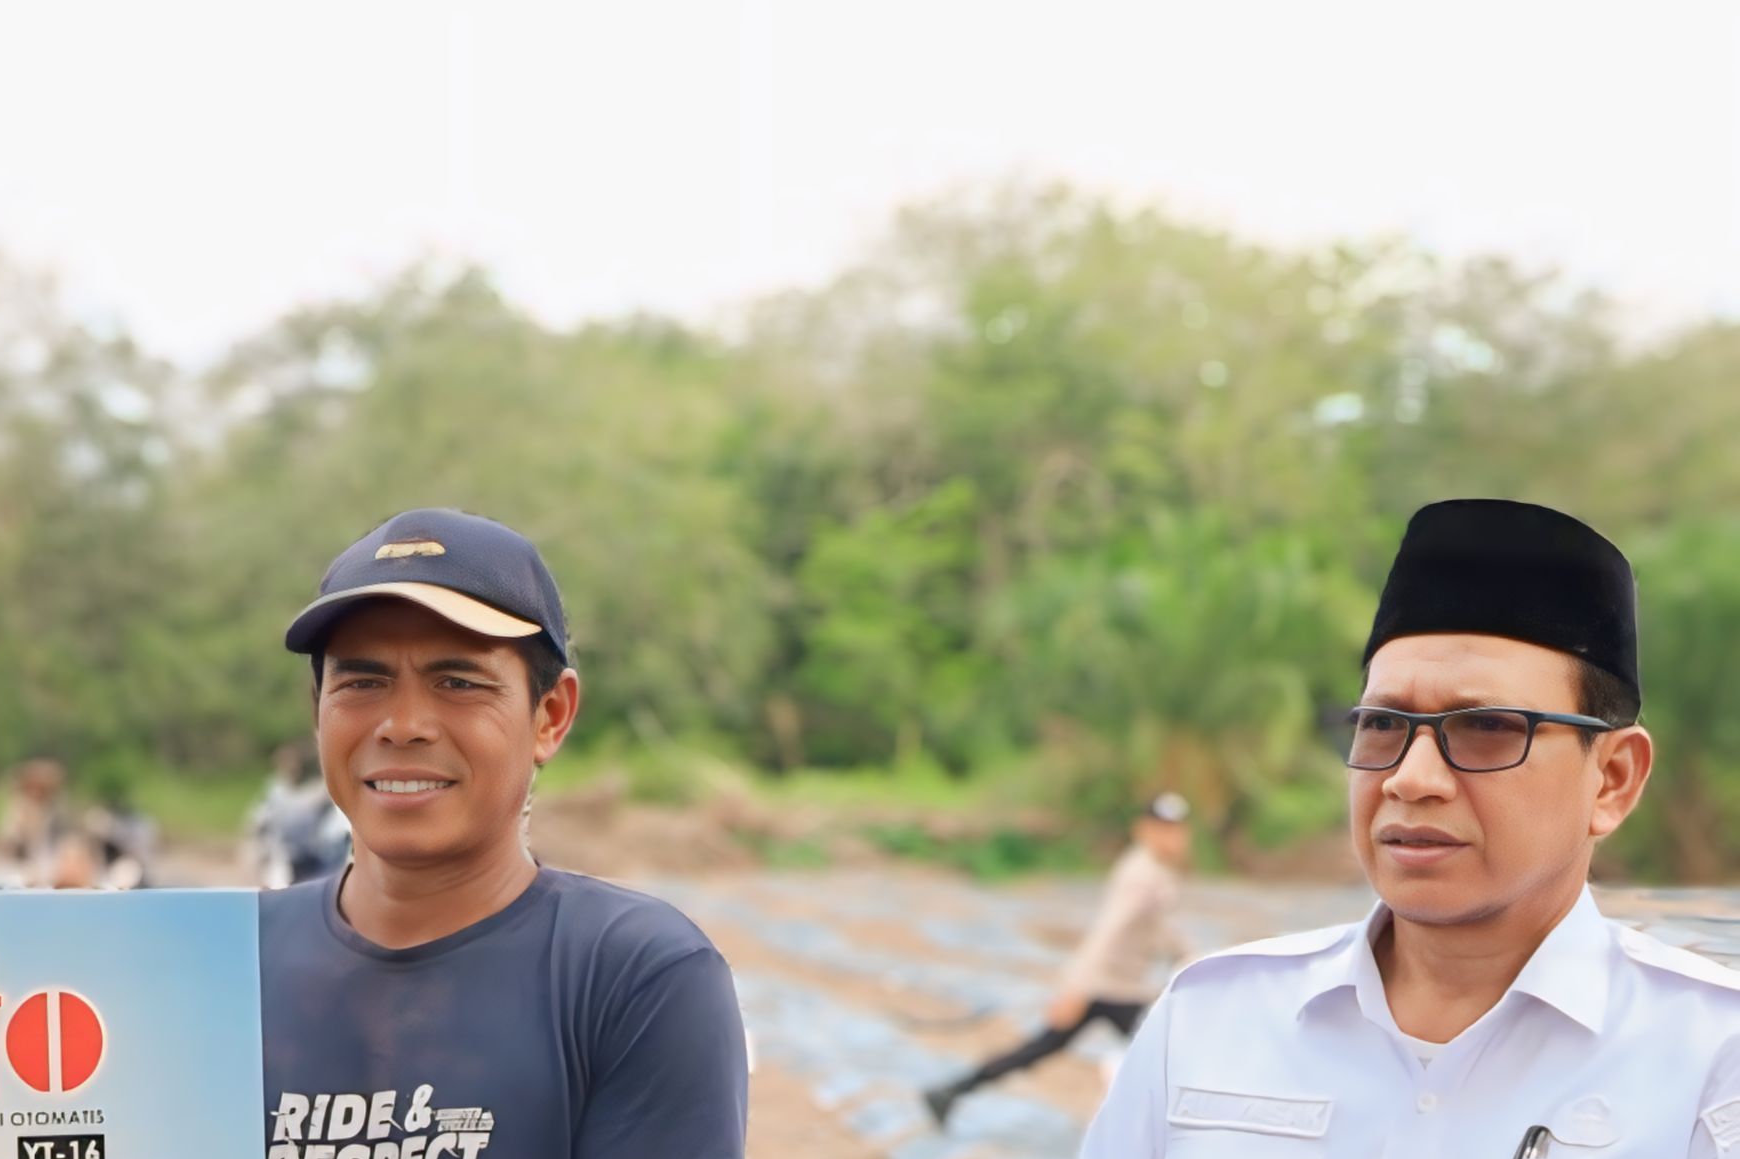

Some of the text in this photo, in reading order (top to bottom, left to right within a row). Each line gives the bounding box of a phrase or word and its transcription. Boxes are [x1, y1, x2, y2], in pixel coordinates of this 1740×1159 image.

[10, 1109, 105, 1126] OTOMATIS
[271, 1090, 399, 1142] RIDE
[404, 1083, 434, 1132] &
